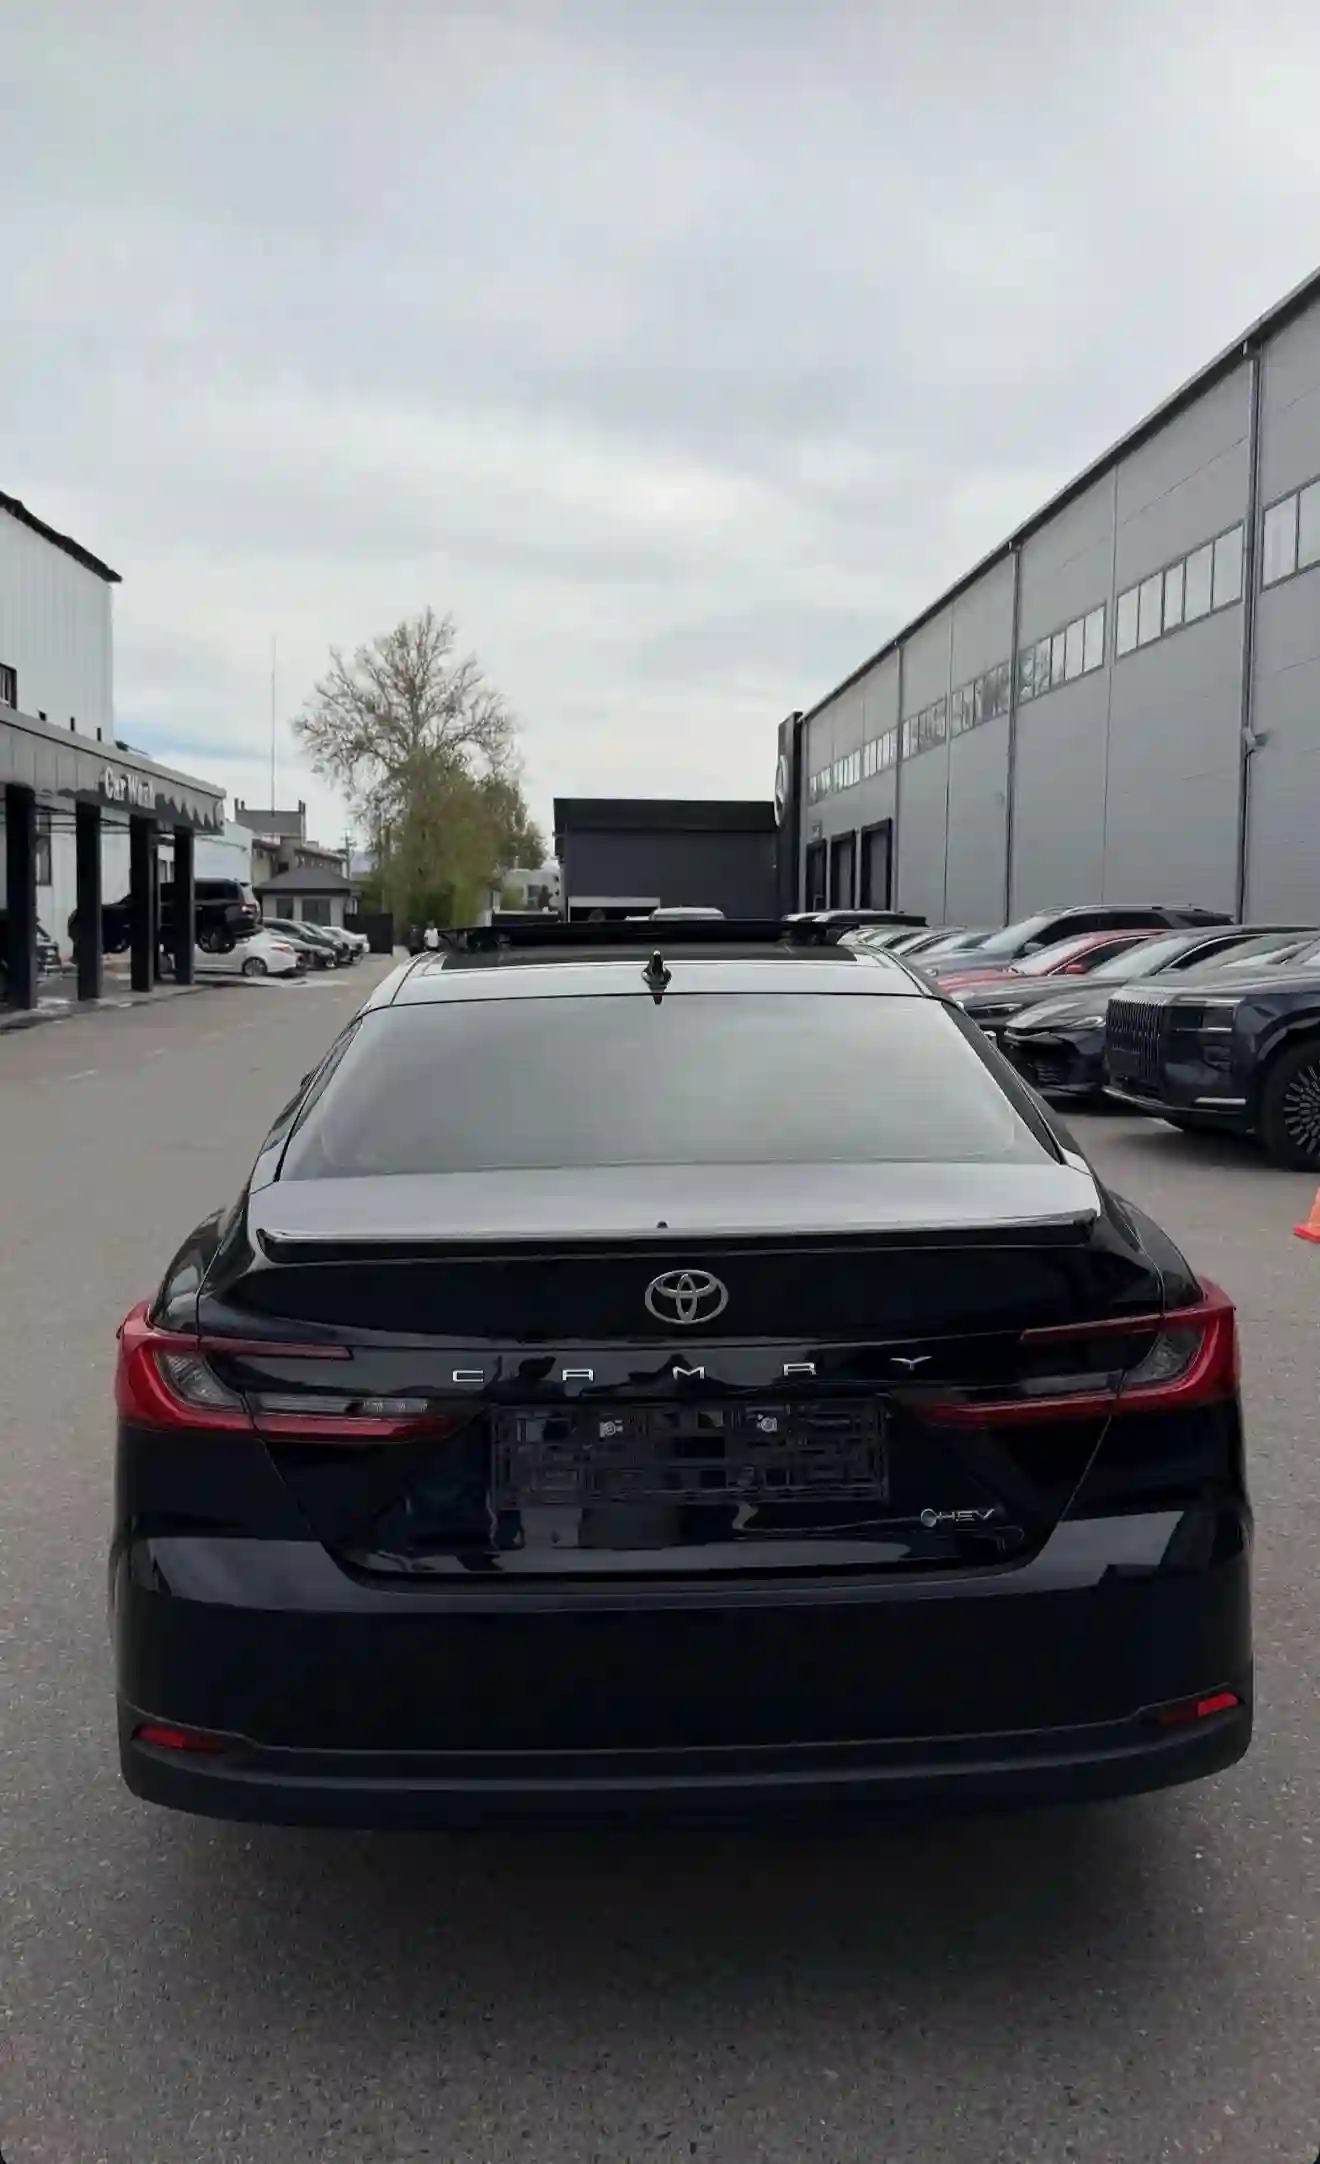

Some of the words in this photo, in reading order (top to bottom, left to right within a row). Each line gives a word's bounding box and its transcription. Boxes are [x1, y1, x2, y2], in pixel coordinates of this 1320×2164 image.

[105, 766, 126, 801] Car
[452, 1355, 933, 1383] CAMRY
[939, 1508, 996, 1522] HEV
